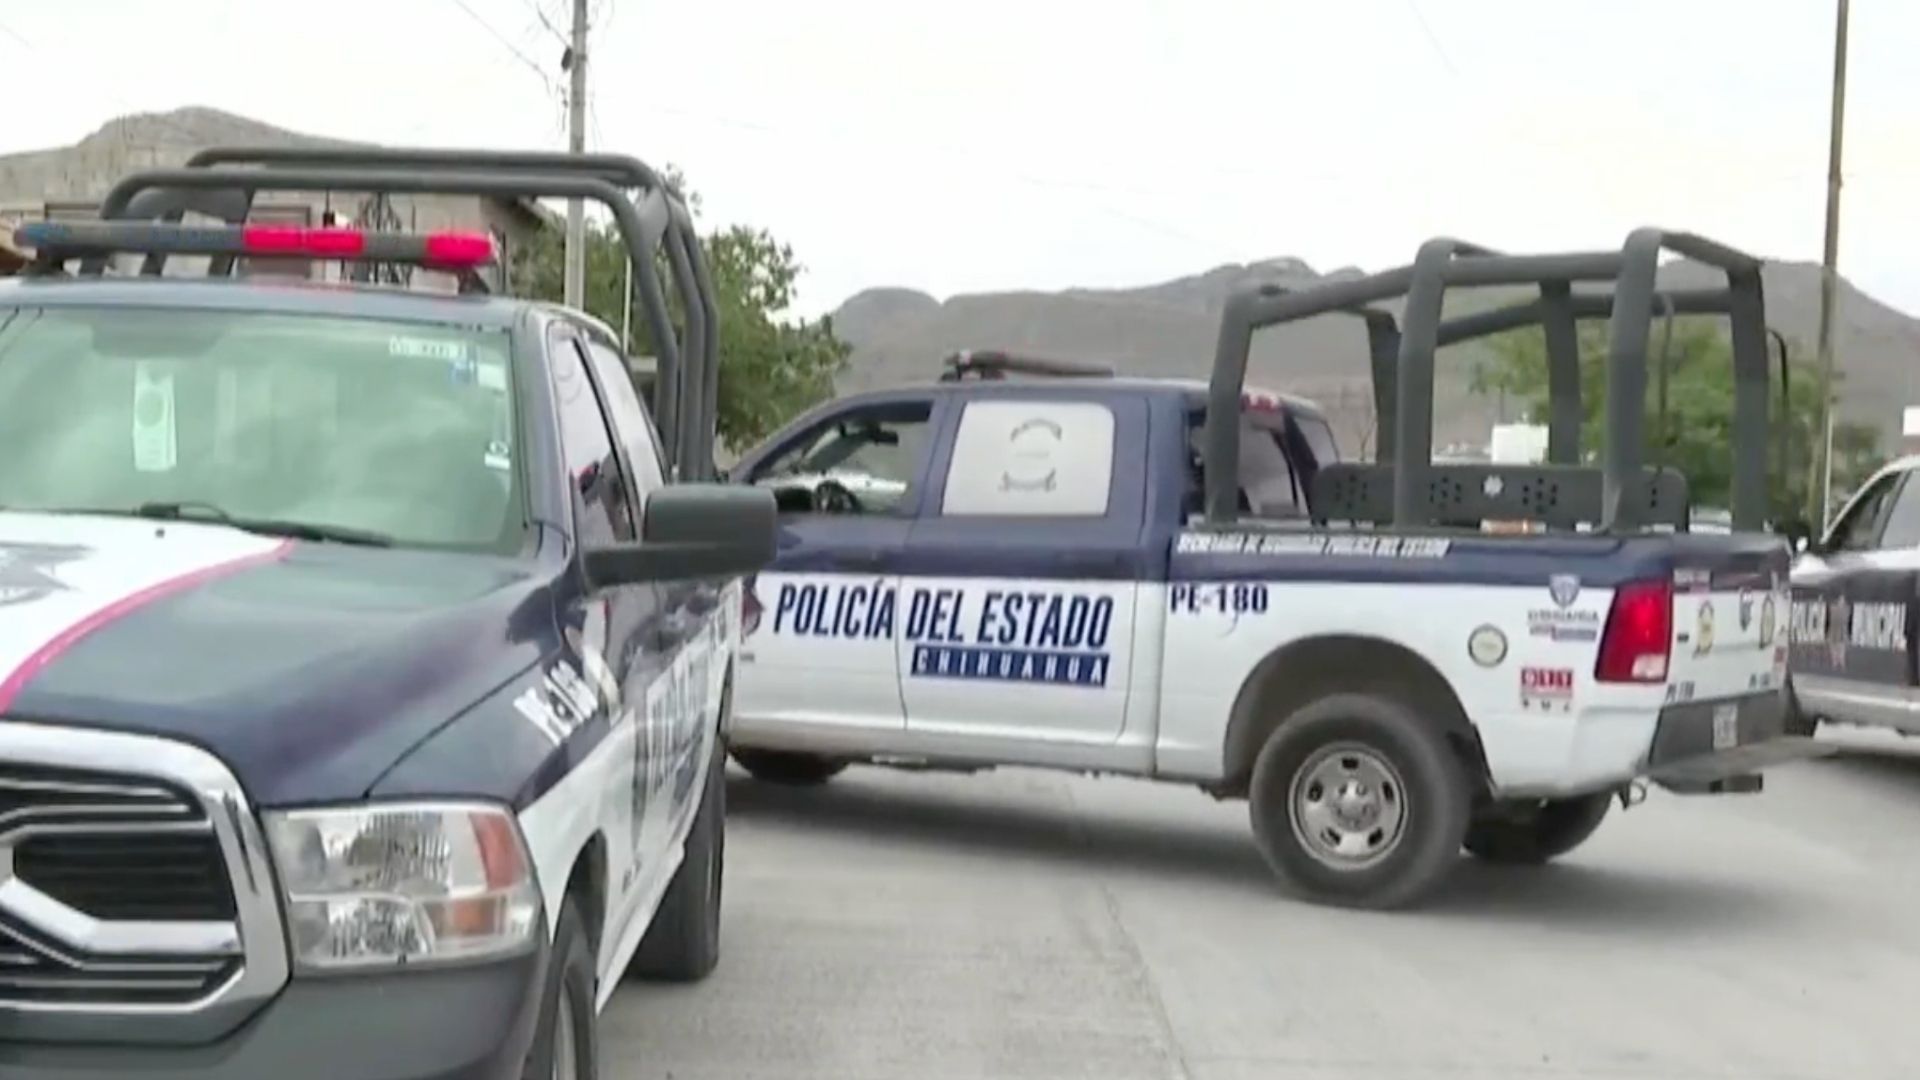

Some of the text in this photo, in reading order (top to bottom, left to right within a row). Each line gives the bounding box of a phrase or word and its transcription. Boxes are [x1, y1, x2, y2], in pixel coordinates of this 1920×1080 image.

[774, 579, 1114, 651] POLICÍA DEL ESTADO
[1171, 584, 1269, 614] PE-180
[915, 647, 1103, 686] CHIHUAHUA
